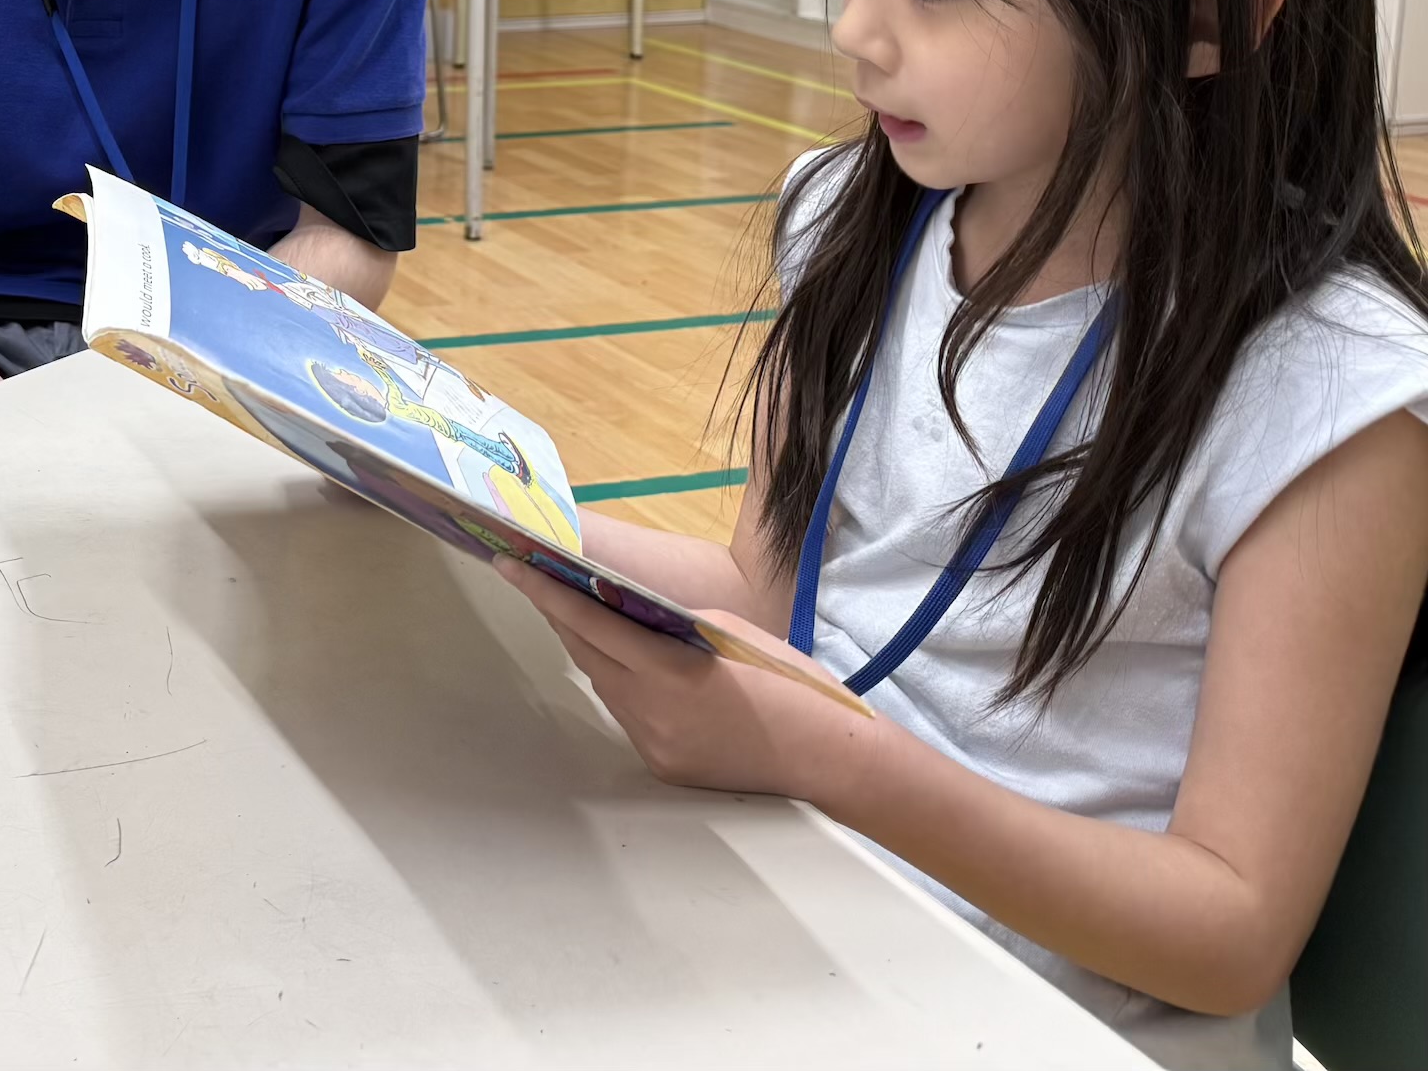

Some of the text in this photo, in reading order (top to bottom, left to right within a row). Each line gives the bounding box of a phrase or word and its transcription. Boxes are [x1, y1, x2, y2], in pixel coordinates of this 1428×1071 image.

[143, 262, 152, 270] a
[143, 269, 152, 292] meet
[140, 290, 152, 327] would
